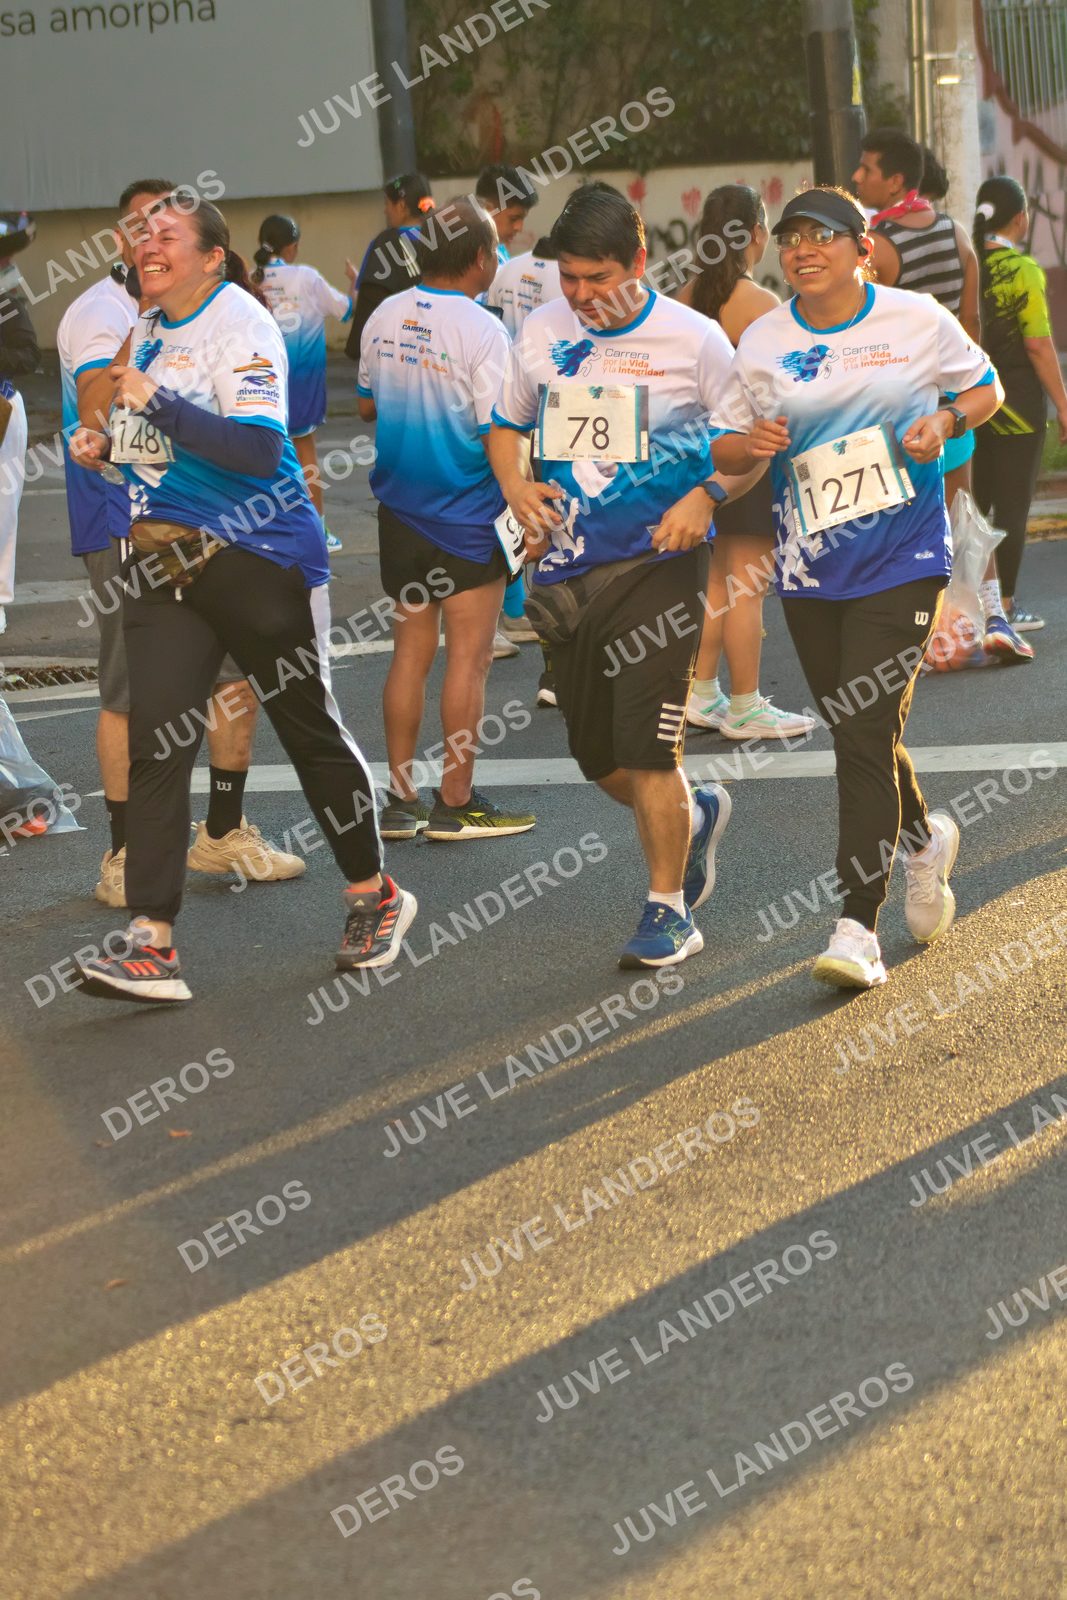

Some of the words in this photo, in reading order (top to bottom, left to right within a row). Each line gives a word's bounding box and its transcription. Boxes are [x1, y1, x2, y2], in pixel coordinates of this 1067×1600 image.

[50, 0, 215, 34] amorpha
[605, 348, 650, 360] Carrera
[842, 343, 890, 357] Carrera
[869, 351, 892, 359] Vida
[629, 359, 649, 368] Vida
[567, 416, 610, 451] 78
[804, 463, 889, 520] 1271
